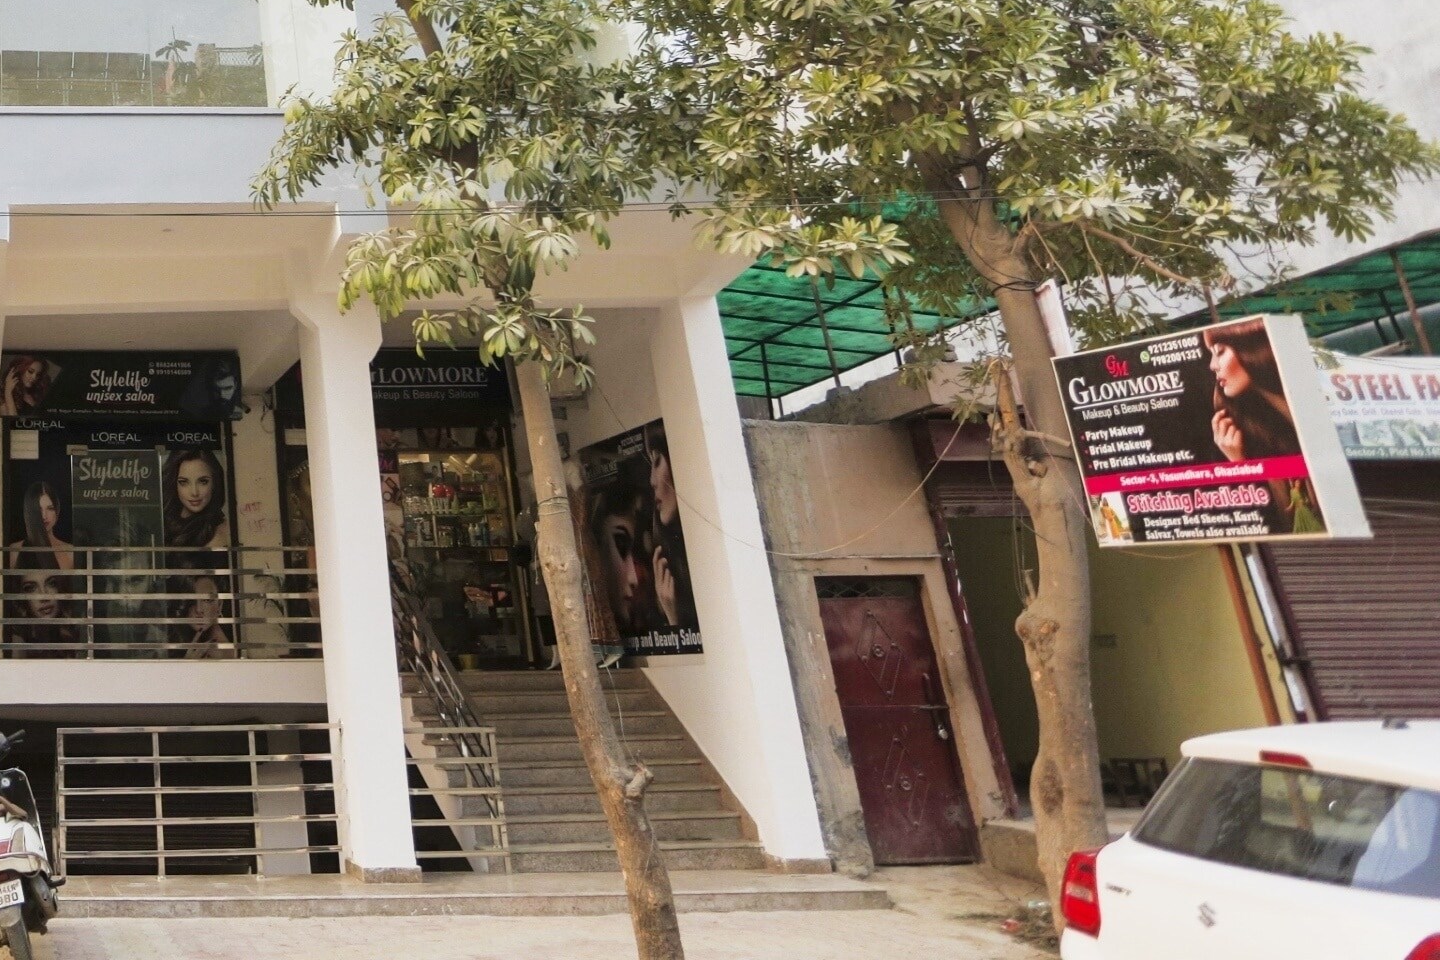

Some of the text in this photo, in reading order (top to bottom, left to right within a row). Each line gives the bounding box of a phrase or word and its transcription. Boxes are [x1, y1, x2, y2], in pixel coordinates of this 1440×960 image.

[90, 369, 150, 390] Stylelife
[371, 367, 488, 384] LOWMORE
[86, 390, 154, 404] unisex salon
[403, 390, 411, 399] &
[413, 388, 445, 400] Beauty
[448, 388, 480, 399] Saloon
[1068, 370, 1184, 406] GLOWMORE
[1330, 373, 1412, 402] STEEL
[1082, 398, 1179, 421] Makeup & Beauty Saloon
[1085, 424, 1145, 442] Party Makeup
[1089, 439, 1152, 456] Bridal Makeup
[1093, 450, 1194, 471] Pre Bridal Makeup etc.
[78, 457, 152, 486] Stylelife
[1120, 464, 1264, 486] Sector-3, Vasundhara, Ghaziabad
[83, 486, 150, 500] unisex salon
[1127, 484, 1270, 513] Stitching Available
[1144, 510, 1264, 528] Designer Bed Sheets, Kurti,
[1145, 524, 1269, 540] Salvar, Towels also available
[640, 630, 654, 648] and
[653, 630, 679, 650] Beauty
